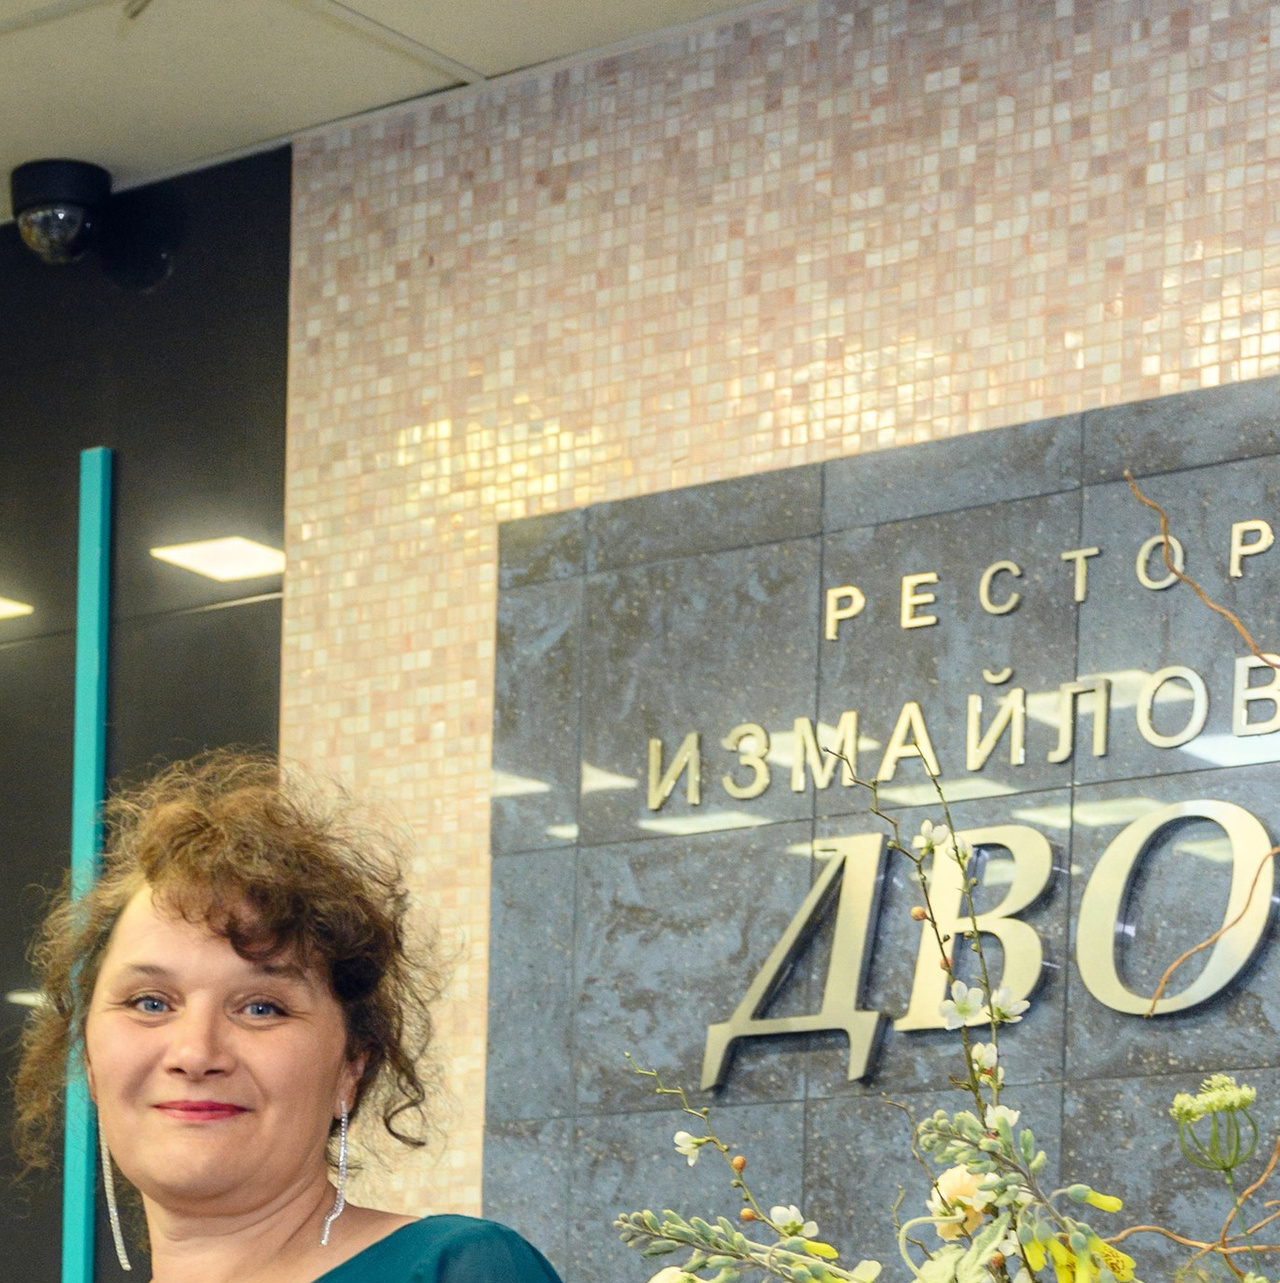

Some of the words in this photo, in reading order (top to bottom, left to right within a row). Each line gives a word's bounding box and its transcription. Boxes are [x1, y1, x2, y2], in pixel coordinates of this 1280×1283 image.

[825, 519, 1275, 641] РЕСТОР
[647, 652, 1280, 811] ИЗМАЙЛОВ
[700, 799, 1275, 1092] ДВО
